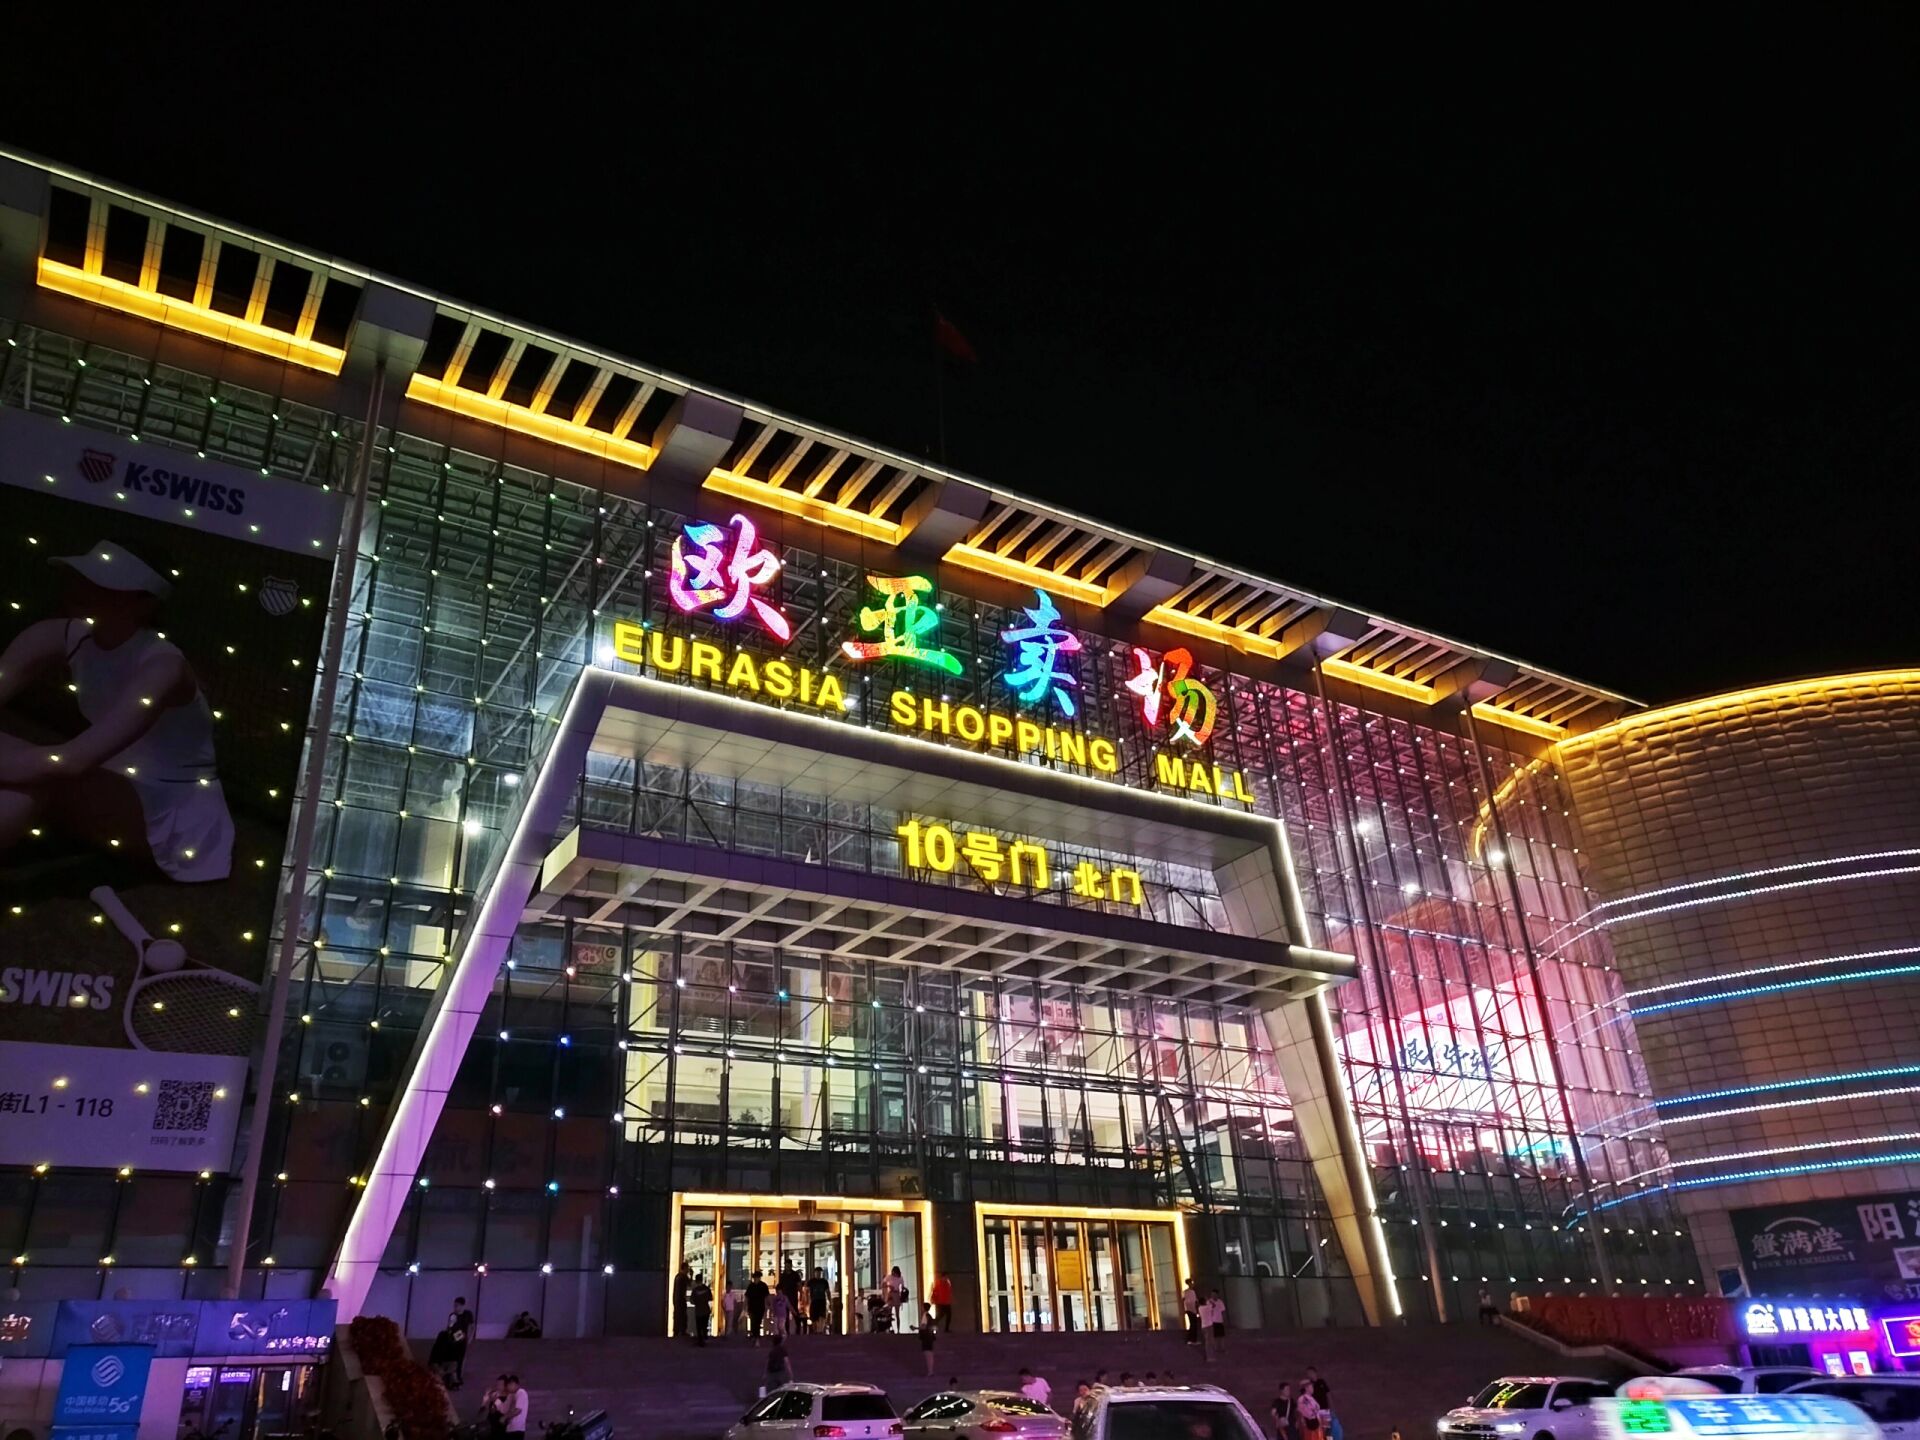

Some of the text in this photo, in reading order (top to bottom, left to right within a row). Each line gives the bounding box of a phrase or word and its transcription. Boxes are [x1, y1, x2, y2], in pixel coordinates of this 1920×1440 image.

[669, 513, 1219, 747] 欧亚卖场
[612, 622, 1257, 806] EURASIA SHOPPING MALL
[895, 815, 1145, 906] 10号门 北门
[75, 1097, 114, 1118] 118
[1751, 1226, 1845, 1259] 蟹满堂
[1857, 1199, 1920, 1241] 阳
